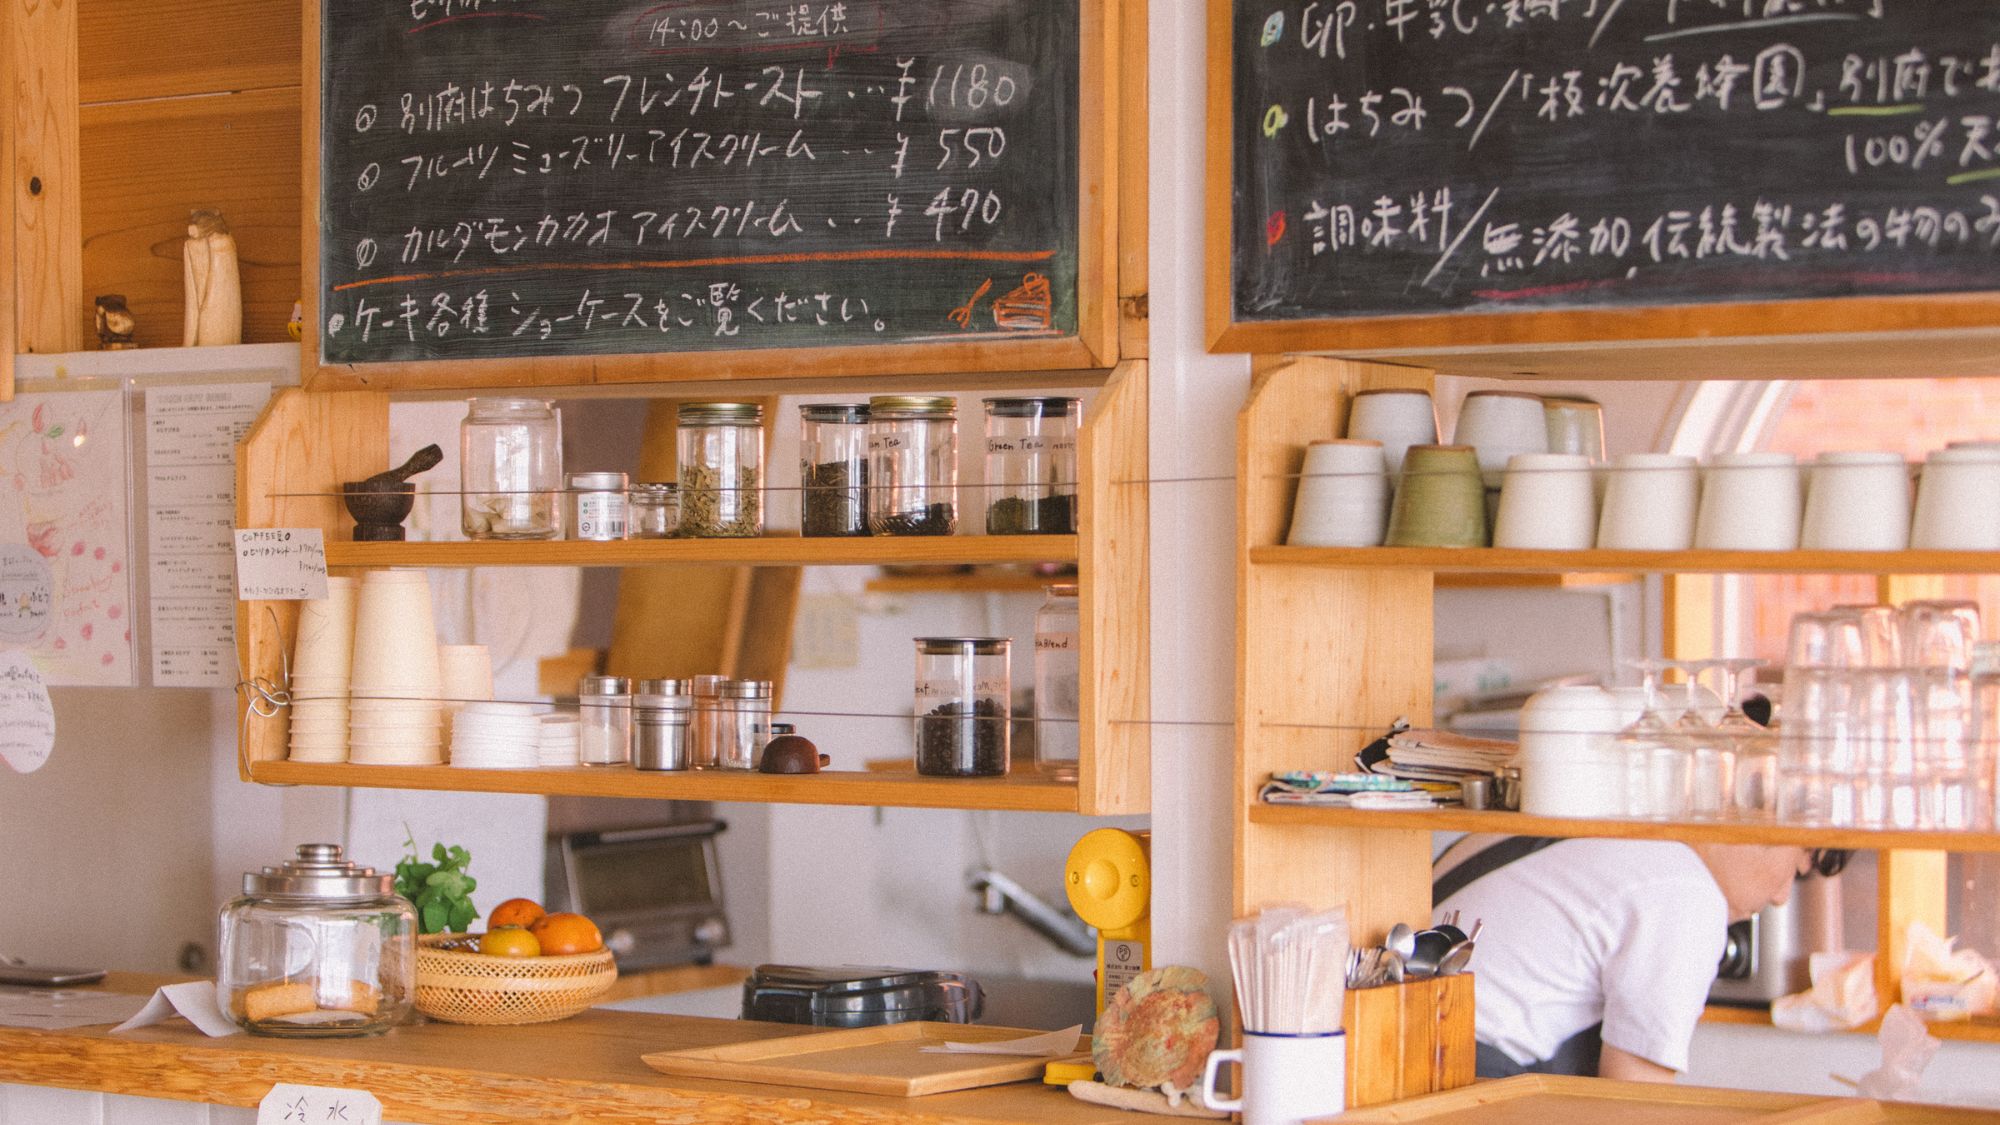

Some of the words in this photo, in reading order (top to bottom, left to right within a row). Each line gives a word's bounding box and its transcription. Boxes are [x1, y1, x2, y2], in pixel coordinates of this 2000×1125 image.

[883, 436, 901, 448] Tea
[989, 439, 1014, 452] Green
[1019, 438, 1045, 450] Tea
